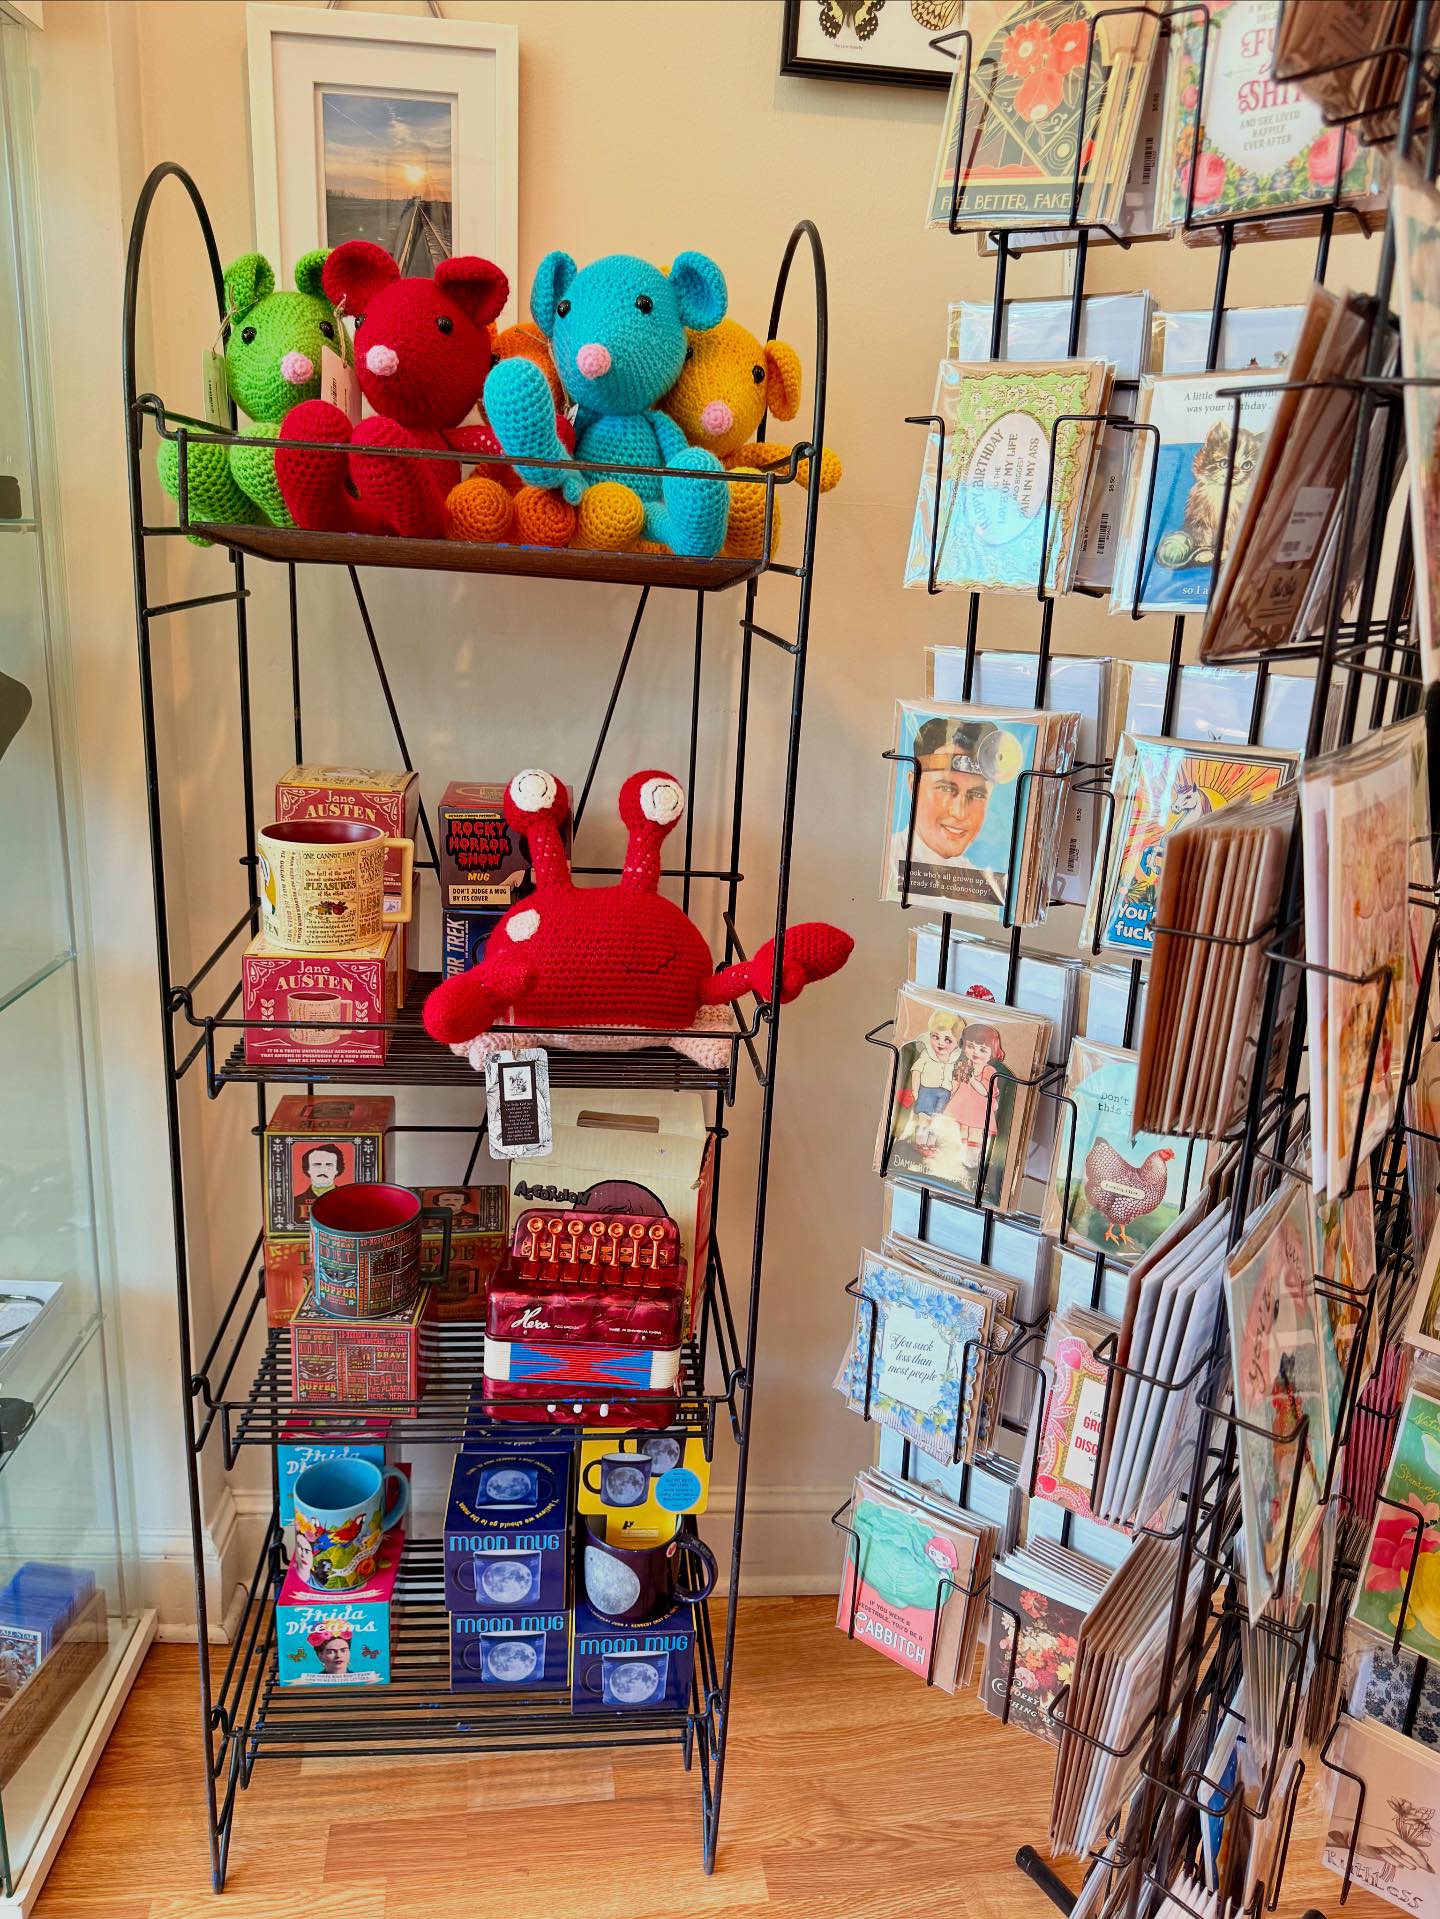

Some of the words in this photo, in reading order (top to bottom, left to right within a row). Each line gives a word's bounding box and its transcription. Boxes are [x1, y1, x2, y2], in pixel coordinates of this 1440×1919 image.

[1258, 114, 1273, 126] SHE
[1274, 110, 1300, 123] LIVED
[1243, 139, 1266, 151] EVER
[974, 194, 1028, 210] BETTER,
[1184, 392, 1190, 400] A
[1192, 391, 1213, 401] little
[1186, 405, 1202, 413] was
[1204, 404, 1224, 415] your
[1228, 400, 1267, 413] bthday
[1029, 438, 1040, 458] ASS
[973, 428, 1004, 488] BIRTHDAY
[1004, 460, 1014, 476] MY
[1026, 460, 1036, 476] MY
[1024, 480, 1032, 490] IN
[326, 790, 355, 803] Jane
[305, 804, 378, 822] AUSTEN
[451, 820, 507, 838] ROCKY
[449, 836, 509, 854] HORROR
[458, 852, 500, 866] SHOW
[467, 872, 490, 882] MUG
[910, 880, 927, 888] ready
[930, 881, 940, 889] for
[923, 870, 940, 879] who's
[952, 875, 974, 884] grown
[975, 878, 984, 886] up
[304, 881, 356, 890] PLEASURES
[447, 918, 464, 952] TREK
[297, 960, 330, 974] Jane
[275, 974, 354, 992] AUSTEN
[1098, 1102, 1121, 1114] this
[514, 1180, 592, 1206] ACCORDION
[320, 1280, 356, 1299] SUFFER
[511, 1306, 551, 1328] Hero
[890, 1333, 912, 1350] You
[912, 1340, 934, 1351] suck
[896, 1350, 911, 1362] less
[912, 1353, 932, 1366] than
[368, 1376, 392, 1385] TEAR
[396, 1374, 407, 1384] UP
[888, 1365, 909, 1375] most
[907, 1370, 938, 1384] people
[300, 1380, 336, 1392] SUFFER
[294, 1446, 360, 1462] Frida
[469, 1514, 480, 1523] the
[499, 1520, 523, 1528] should
[450, 1535, 508, 1551] moon
[294, 1605, 367, 1622] Frida
[877, 1604, 888, 1614] YOU
[889, 1611, 905, 1623] WERE
[286, 1621, 378, 1635] Dreams
[456, 1617, 514, 1633] moon
[892, 1622, 908, 1633] YOU'D
[854, 1612, 926, 1664] CABBITCH
[580, 1638, 638, 1655] moon
